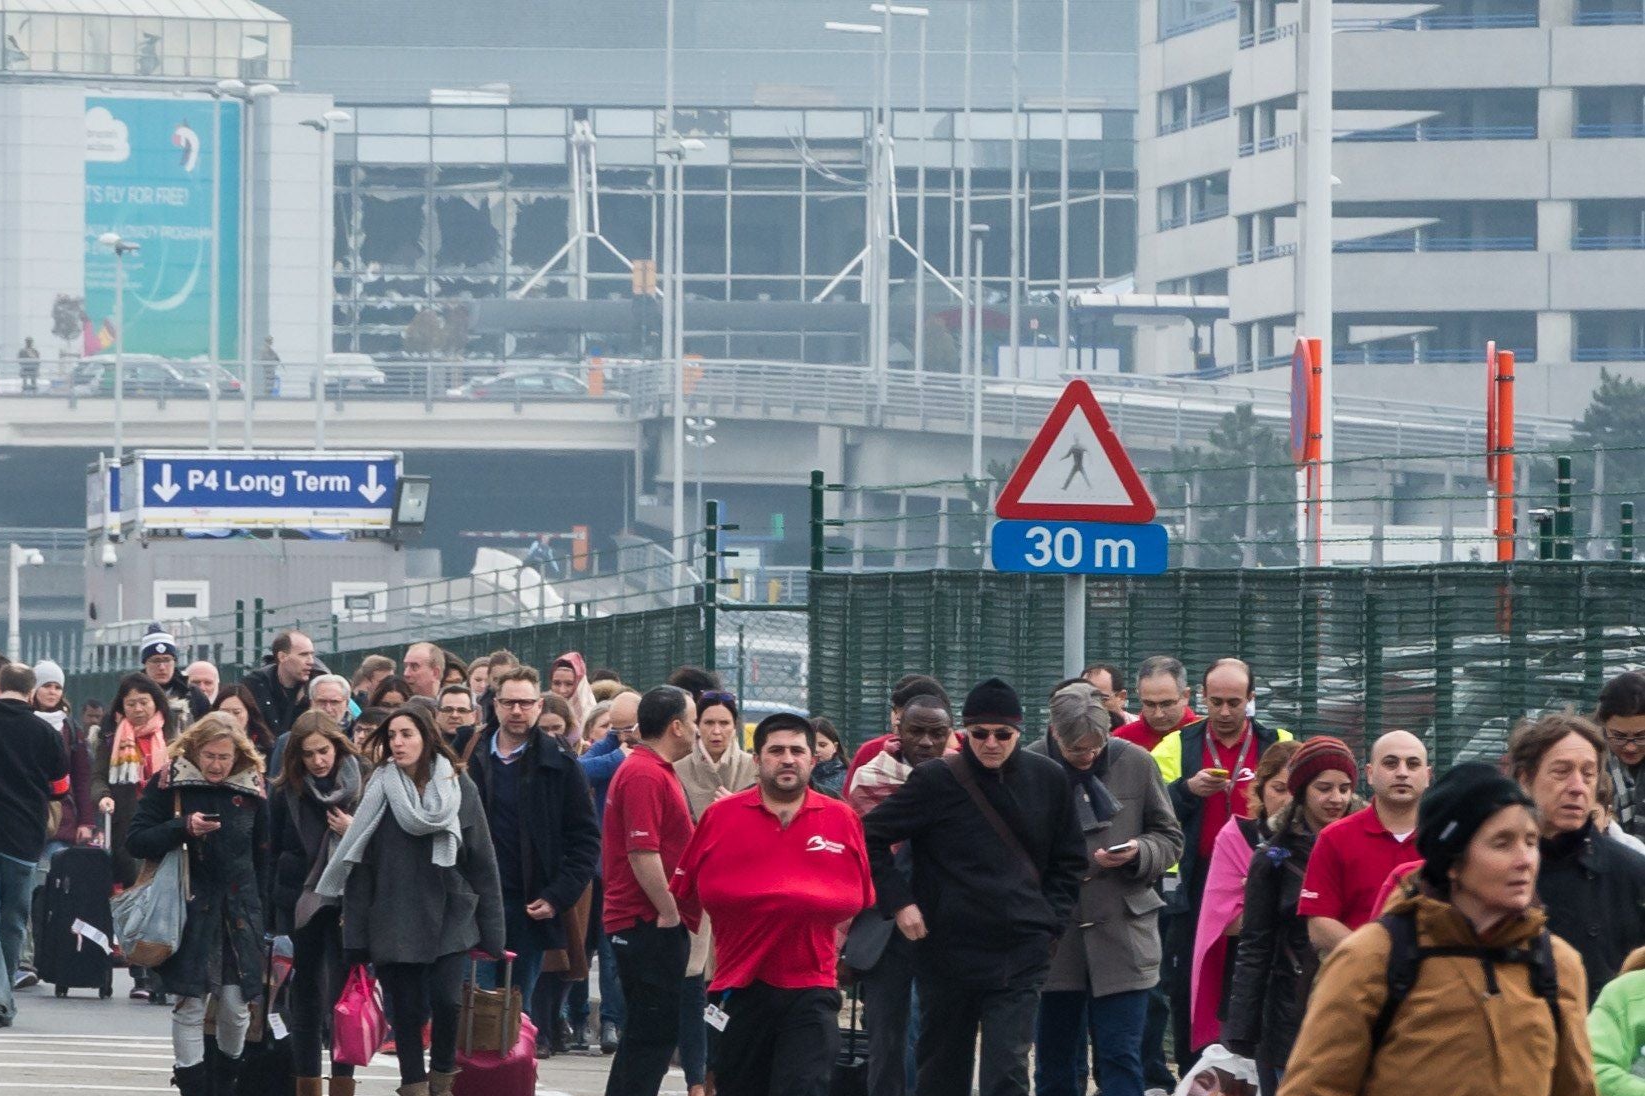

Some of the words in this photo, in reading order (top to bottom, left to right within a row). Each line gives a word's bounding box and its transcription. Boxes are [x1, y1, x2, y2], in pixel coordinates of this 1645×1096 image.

[187, 469, 219, 491] P4
[225, 470, 285, 497] Long
[292, 470, 351, 492] Term
[1025, 526, 1083, 568] 30
[1094, 538, 1136, 568] m
